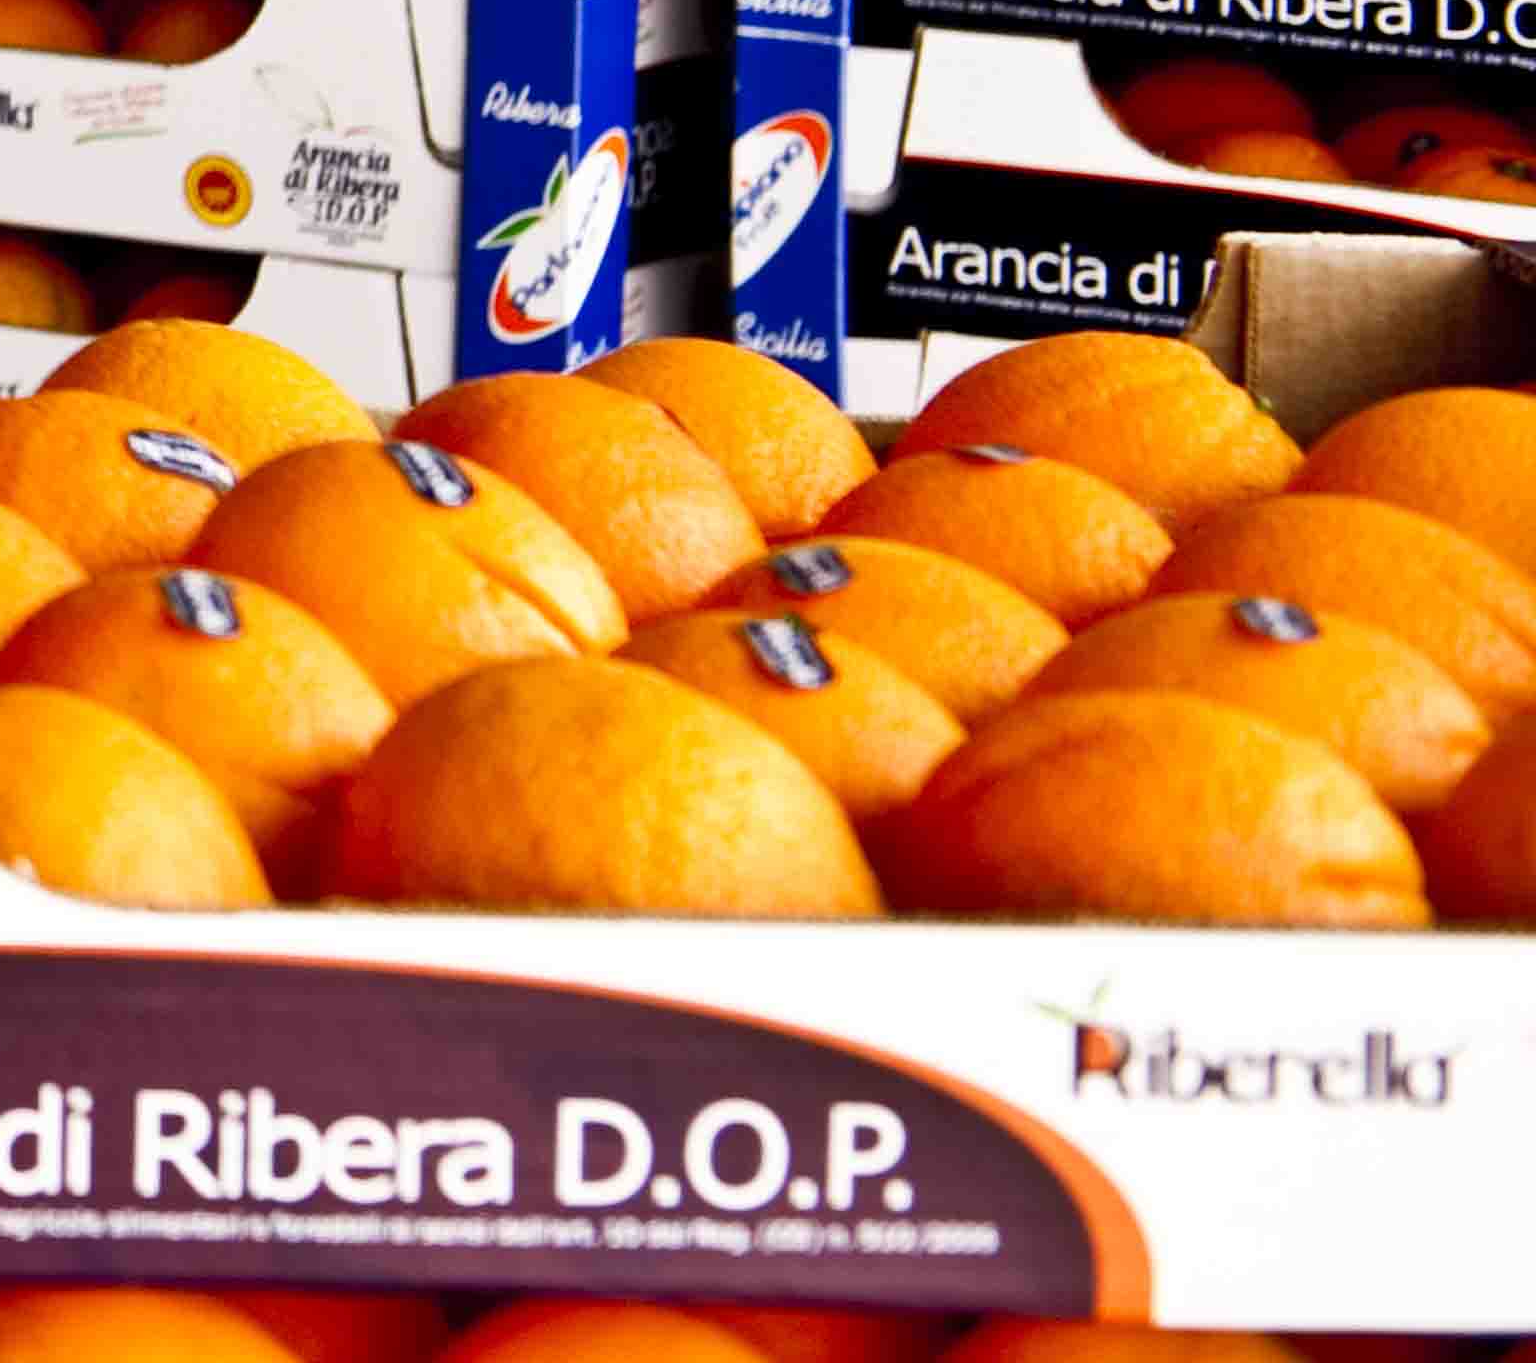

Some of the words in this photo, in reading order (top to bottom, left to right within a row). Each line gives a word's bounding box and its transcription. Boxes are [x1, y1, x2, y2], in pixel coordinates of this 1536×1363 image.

[481, 82, 582, 129] Ribera
[292, 138, 391, 173] Arancia
[283, 167, 308, 192] di
[316, 171, 399, 203] Ribera
[890, 226, 1107, 298] Arancia
[1129, 251, 1179, 307] di
[735, 312, 829, 362] Sicilia
[1072, 1022, 1452, 1106] Riberella
[134, 1087, 514, 1206] Ribera
[555, 1097, 913, 1211] D.O.P.
